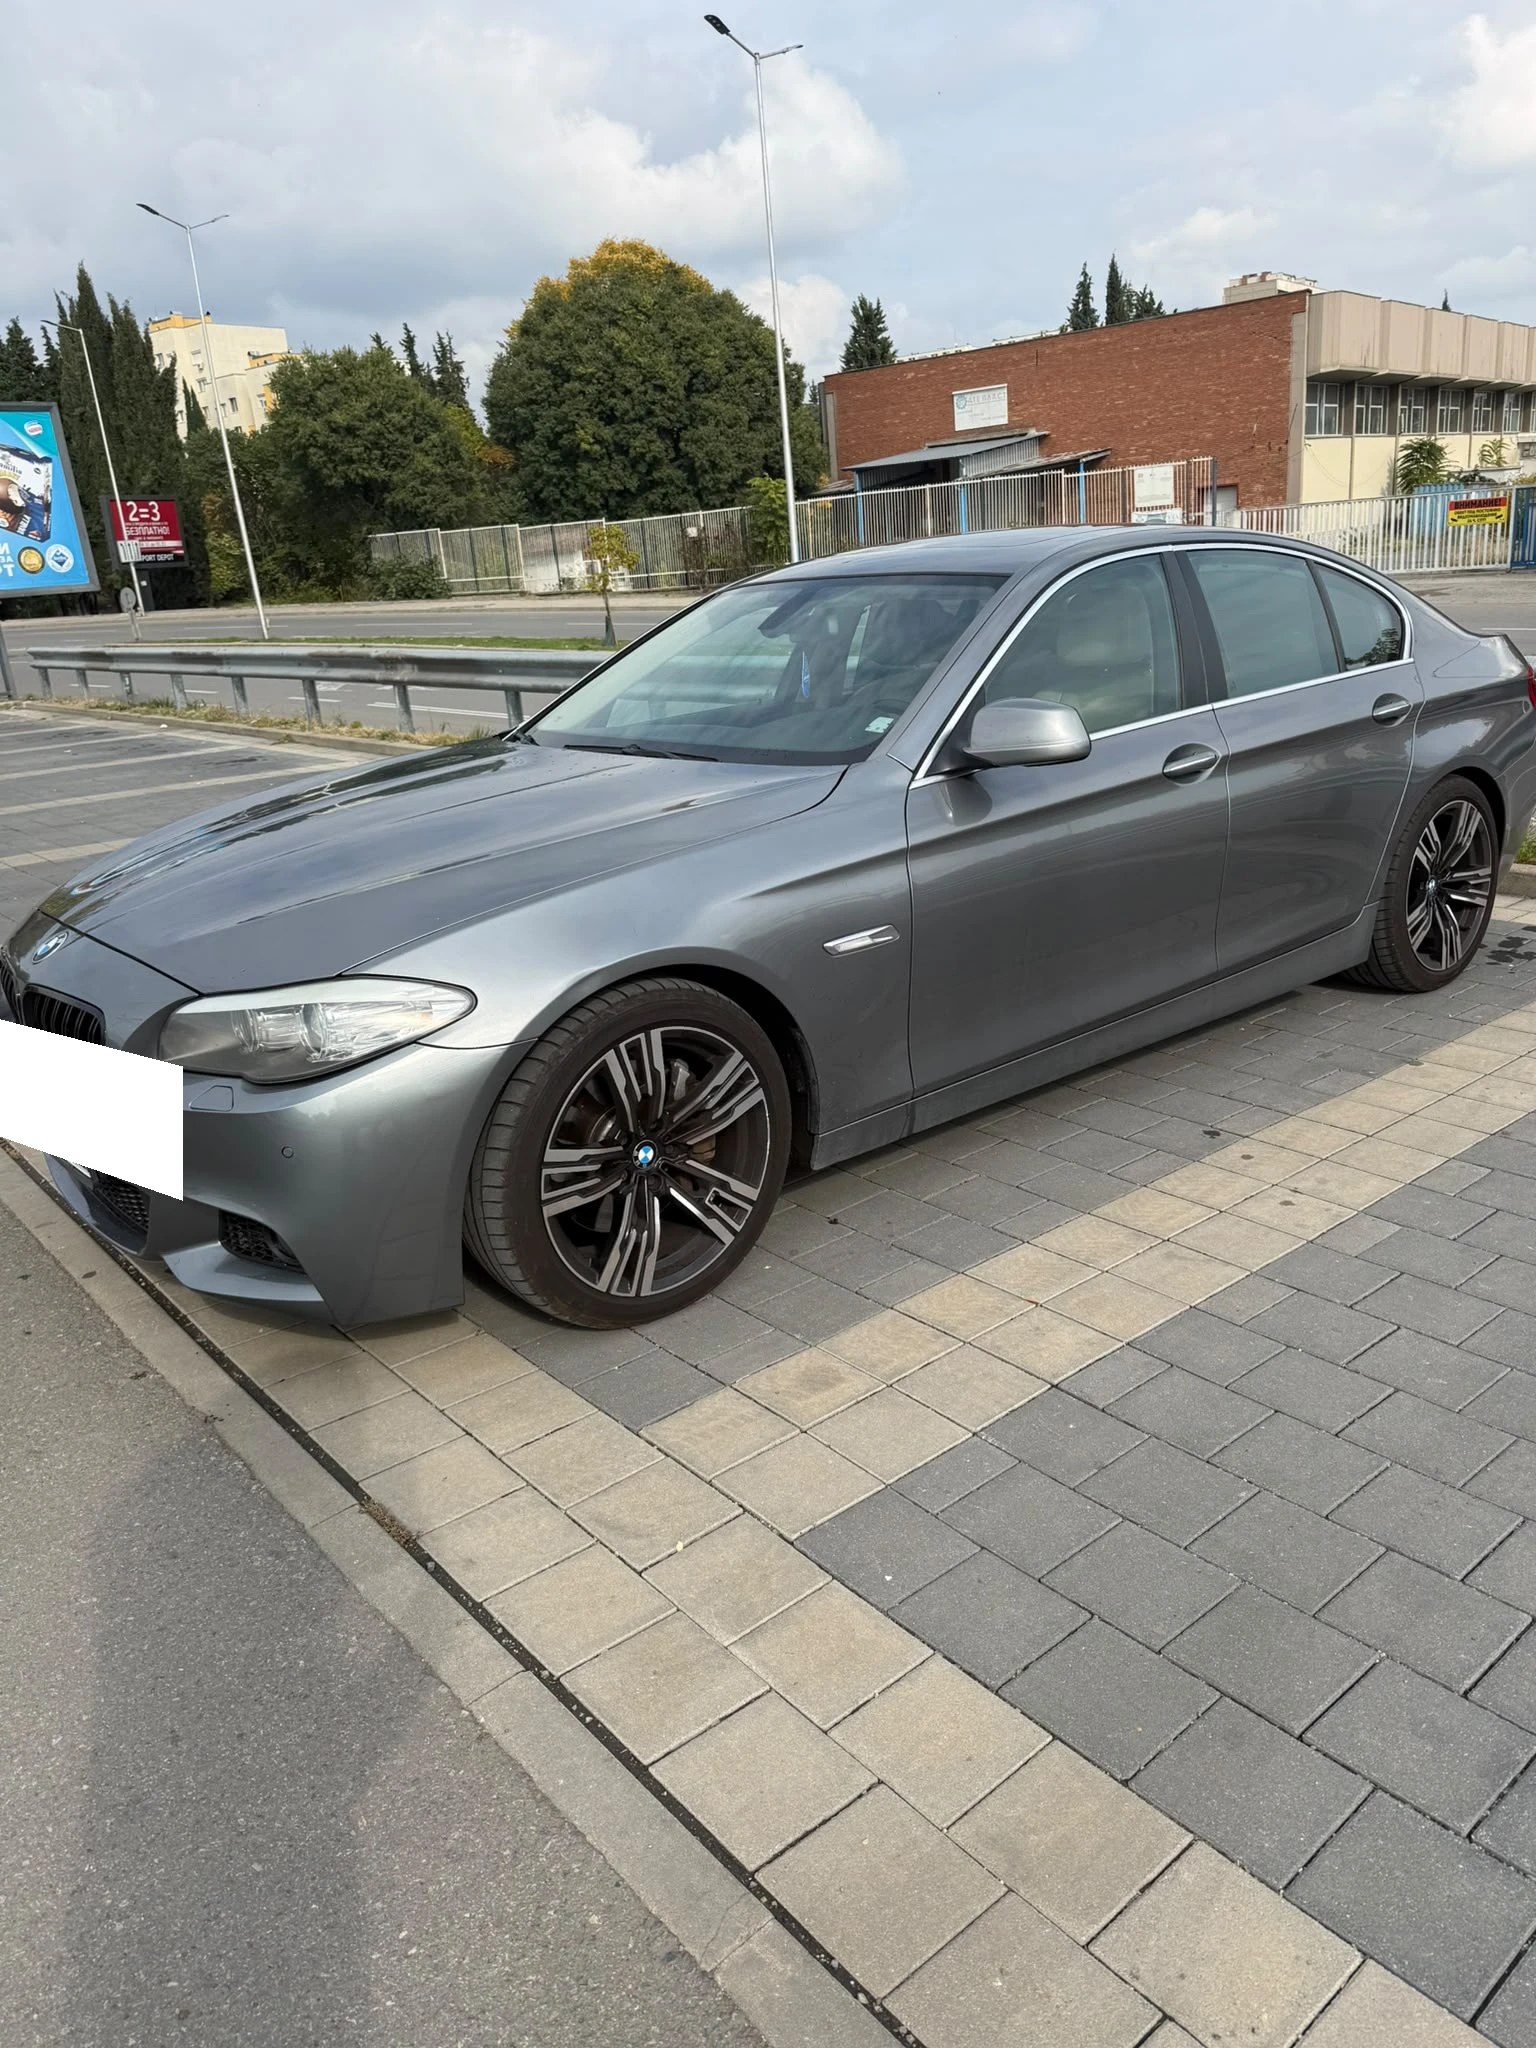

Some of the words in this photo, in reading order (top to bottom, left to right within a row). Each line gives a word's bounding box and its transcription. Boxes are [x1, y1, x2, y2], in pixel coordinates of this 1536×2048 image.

[0, 463, 22, 475] amilia
[1454, 498, 1501, 509] ВНИМАНИЕ!
[126, 501, 160, 521] 2=3
[125, 526, 170, 535] БЕЗПЛАТНО!
